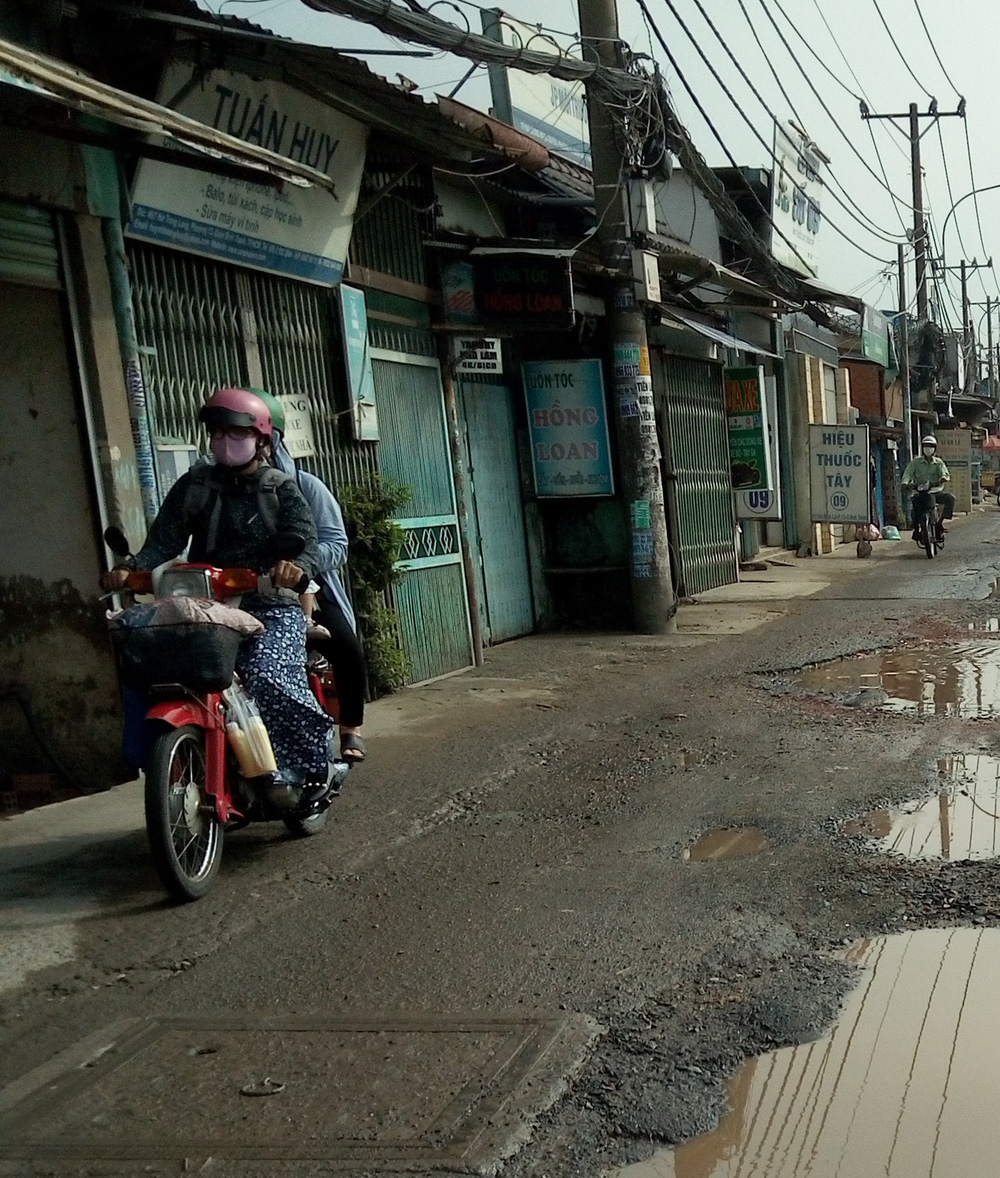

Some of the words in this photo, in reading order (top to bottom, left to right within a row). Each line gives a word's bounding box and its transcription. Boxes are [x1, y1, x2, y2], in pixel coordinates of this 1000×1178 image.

[213, 84, 287, 154] TUẤN
[289, 121, 340, 175] HUY
[554, 370, 575, 389] TÓC
[743, 380, 759, 412] XE
[534, 399, 598, 428] HỒNG
[823, 430, 855, 448] HIỆU
[536, 441, 599, 462] LOAN
[816, 449, 862, 467] THUỐC
[826, 472, 852, 488] TÂY
[833, 495, 846, 507] 09
